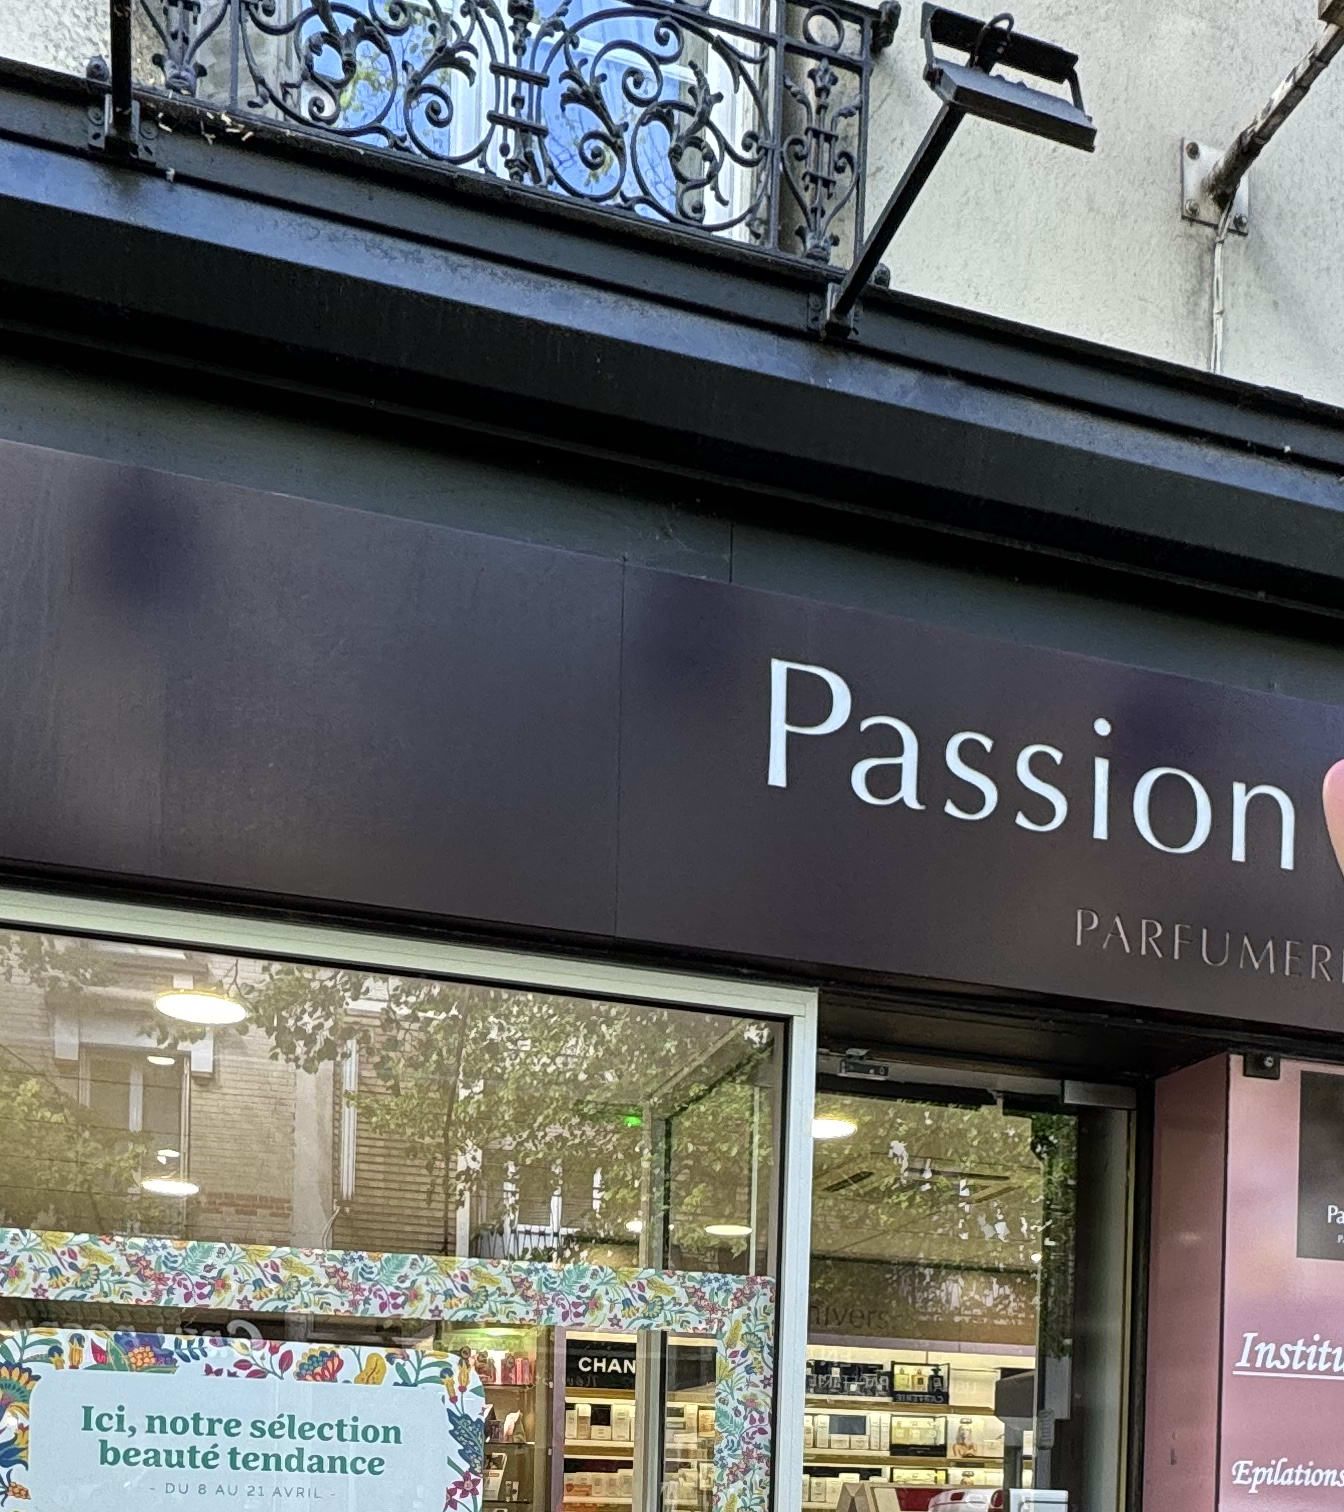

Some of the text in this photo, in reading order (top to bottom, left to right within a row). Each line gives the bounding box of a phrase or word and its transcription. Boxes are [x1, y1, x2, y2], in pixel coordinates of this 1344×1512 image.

[767, 658, 1296, 872] Passion
[809, 1302, 890, 1329] nivers
[578, 1357, 636, 1374] CHAN
[81, 1404, 403, 1445] Ici, notre sélection
[98, 1439, 386, 1476] beauté tendance
[165, 1482, 189, 1495] DU
[198, 1484, 208, 1495] 8
[215, 1484, 240, 1497] AU
[247, 1485, 266, 1498] 21
[272, 1486, 322, 1500] AVRIL
